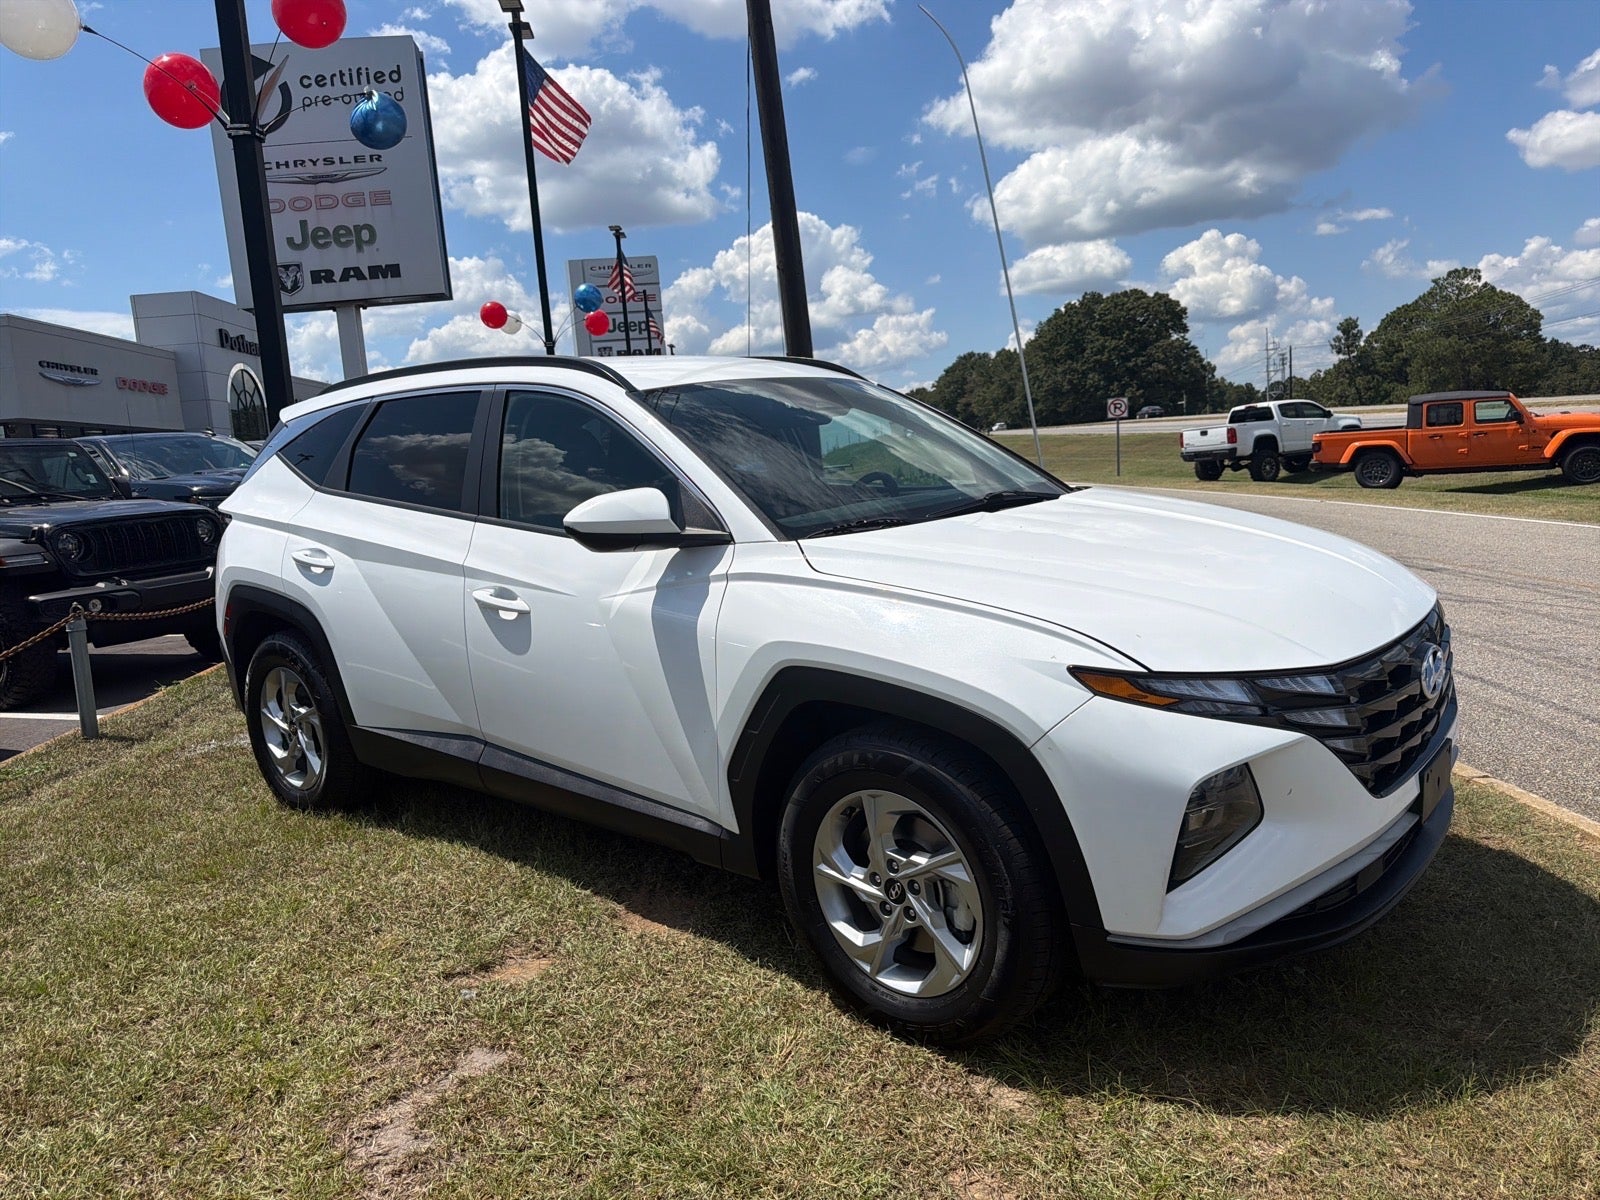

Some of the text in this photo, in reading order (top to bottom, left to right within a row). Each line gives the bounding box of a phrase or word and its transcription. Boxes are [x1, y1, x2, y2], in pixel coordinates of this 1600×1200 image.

[299, 64, 402, 89] certified
[302, 87, 404, 111] pre-od
[286, 219, 377, 253] Jeep
[310, 263, 401, 285] RAM
[590, 263, 652, 271] CHRLER
[608, 318, 648, 335] Jeep
[38, 360, 98, 376] CHRYSLER
[115, 376, 169, 395] DODGE
